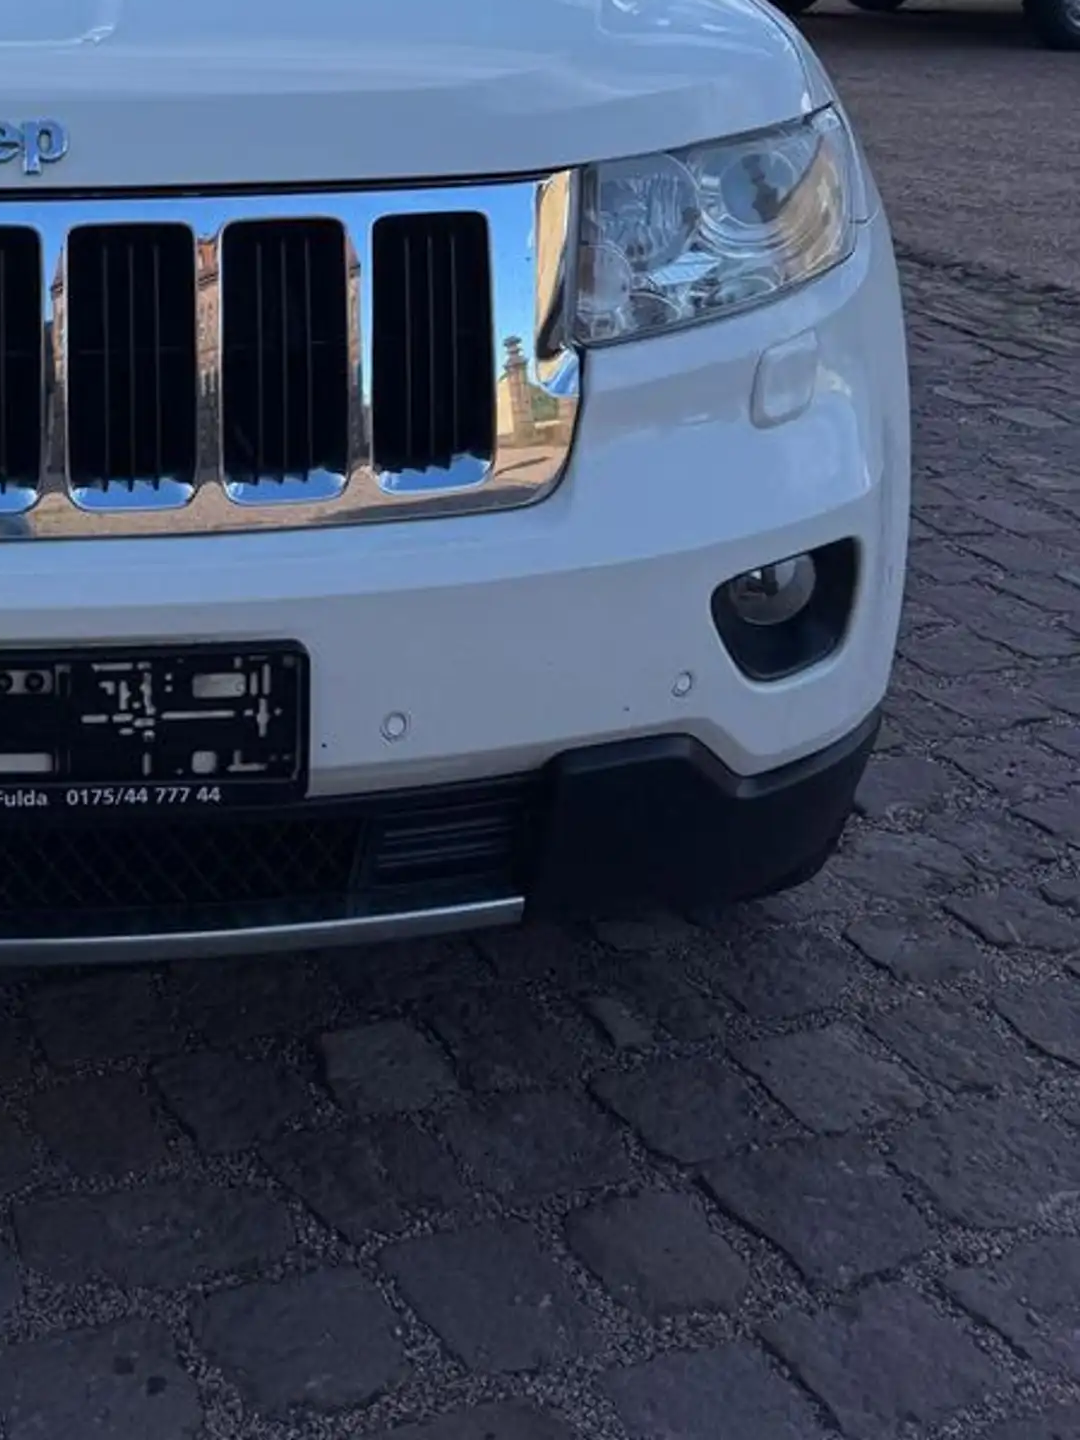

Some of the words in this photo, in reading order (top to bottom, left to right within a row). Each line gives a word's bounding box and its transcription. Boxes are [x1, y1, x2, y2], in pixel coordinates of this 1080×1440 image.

[66, 787, 149, 806] 0175/44
[154, 787, 191, 804] 777
[196, 786, 222, 803] 44
